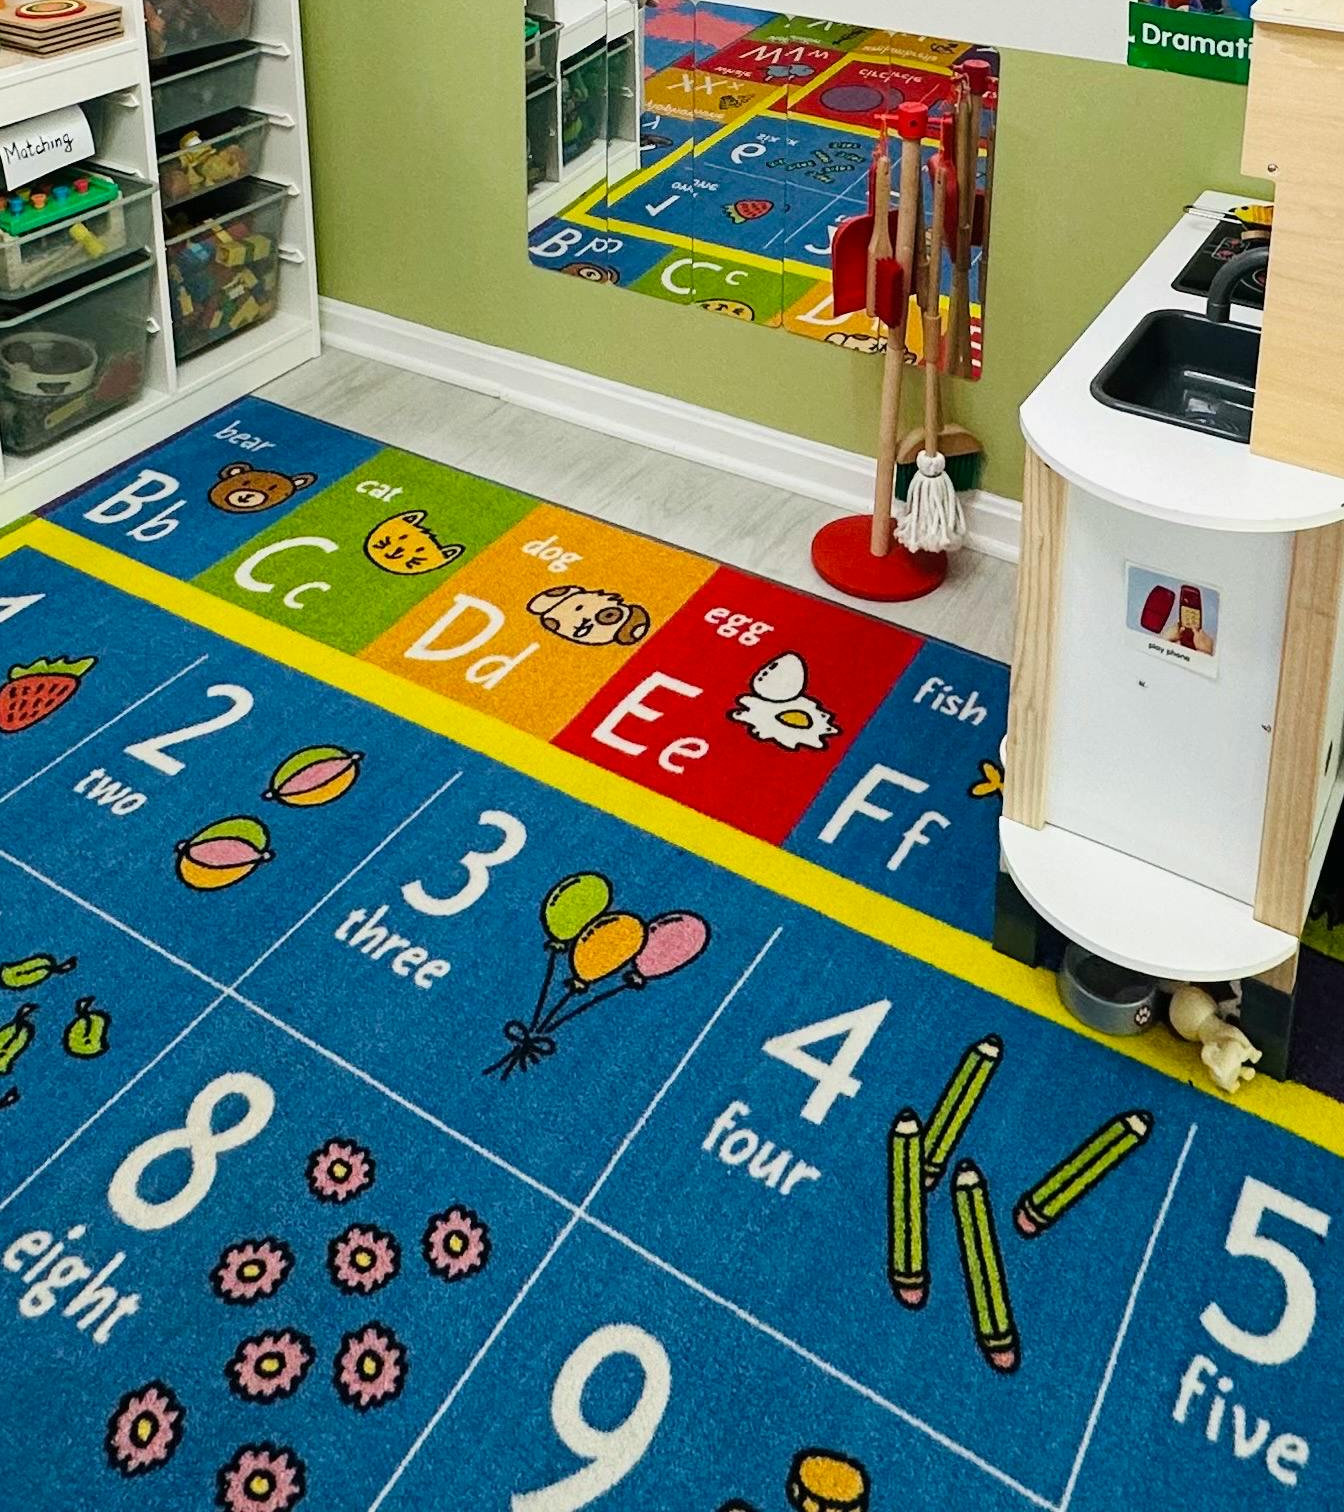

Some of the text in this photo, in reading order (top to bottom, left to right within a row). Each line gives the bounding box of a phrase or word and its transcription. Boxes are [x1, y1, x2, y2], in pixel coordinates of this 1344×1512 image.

[3, 133, 73, 164] Matching
[213, 420, 275, 451] bear
[355, 476, 404, 503] cat
[522, 536, 583, 572] dog
[705, 608, 774, 646] egg
[1148, 643, 1190, 662] play phone
[124, 684, 254, 776] 2
[913, 677, 987, 725] fish
[74, 768, 147, 815] two
[402, 809, 527, 916] 3
[335, 905, 451, 989] three
[761, 999, 892, 1125] 4
[108, 1071, 275, 1231] 8
[701, 1103, 821, 1195] four
[2, 1224, 142, 1344] eight
[1198, 1176, 1331, 1365] 5
[511, 1322, 672, 1512] 9
[1173, 1355, 1309, 1486] five
